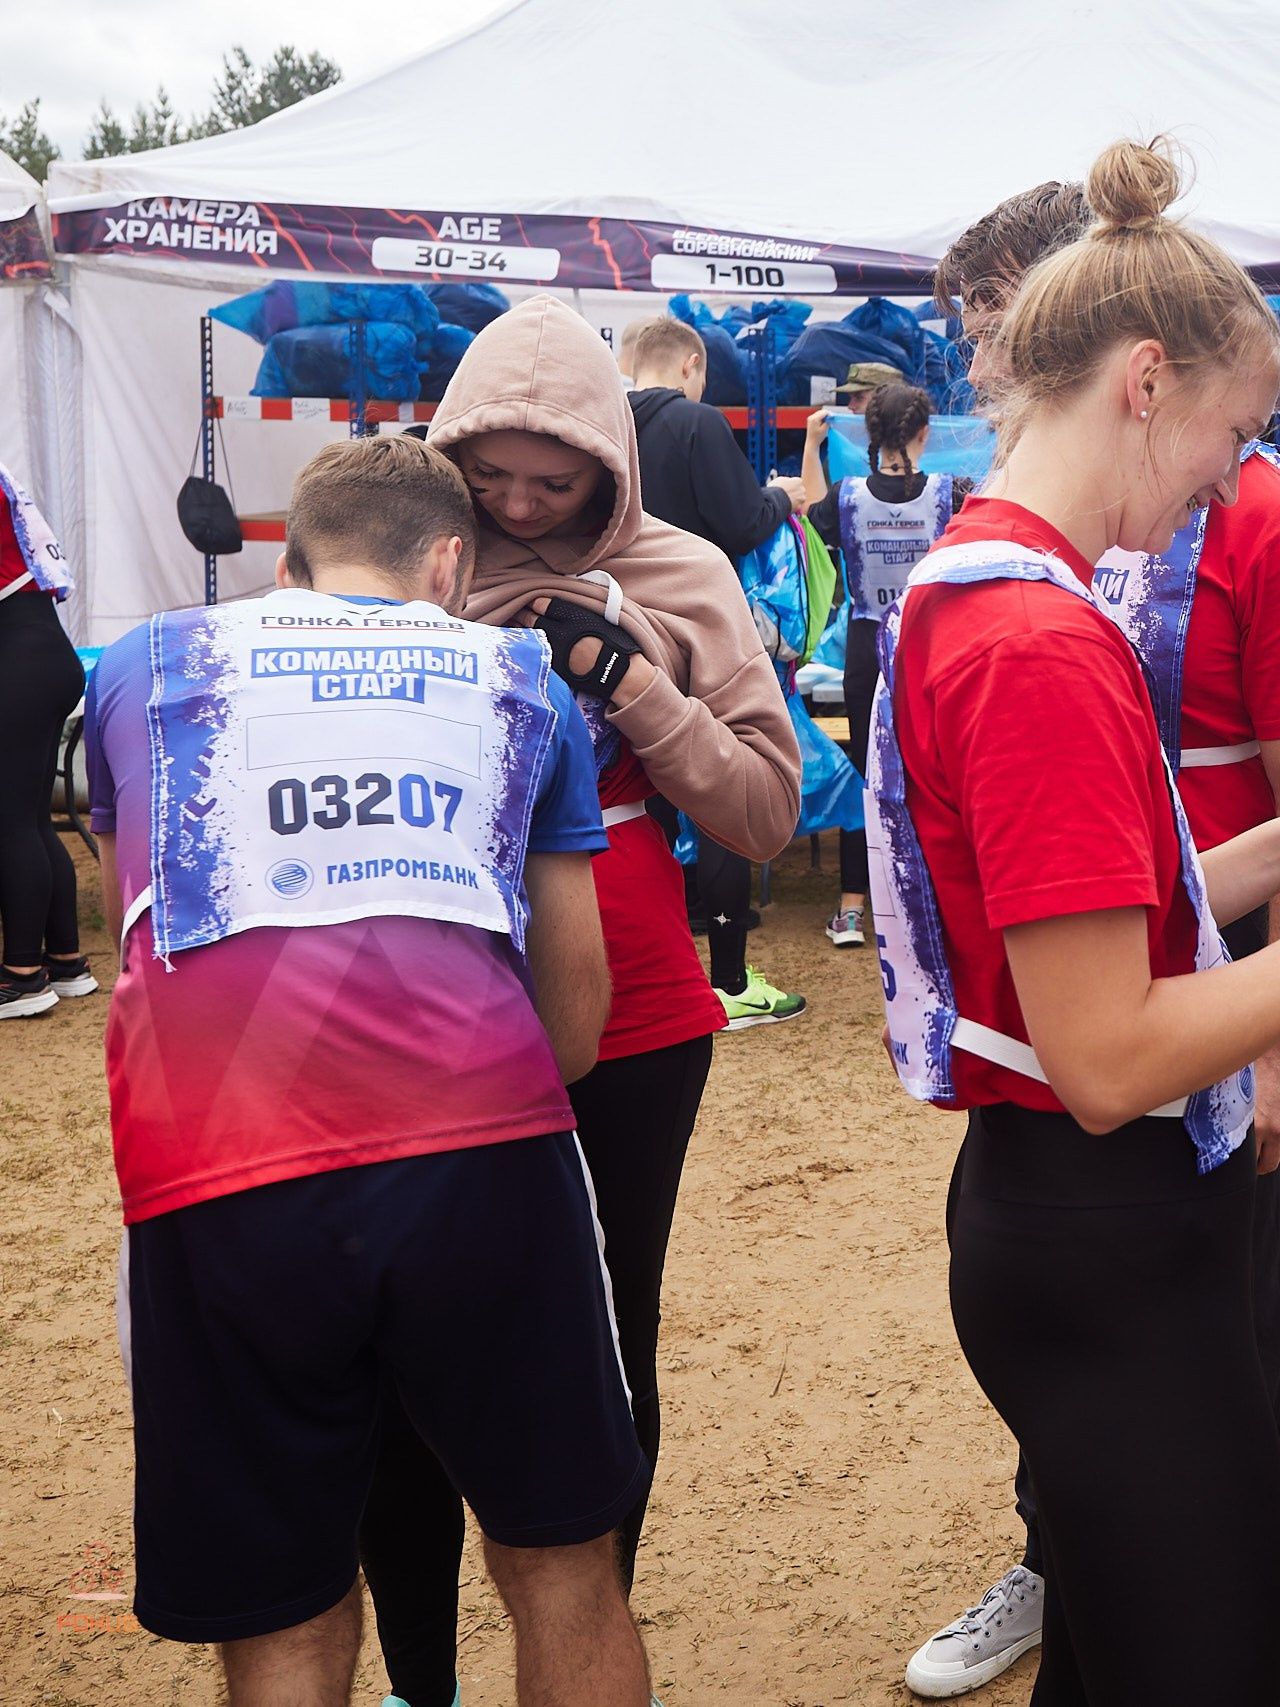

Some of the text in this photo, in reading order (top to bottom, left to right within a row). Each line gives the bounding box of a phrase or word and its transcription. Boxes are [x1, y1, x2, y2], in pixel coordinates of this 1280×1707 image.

[127, 197, 262, 227] КАМЕРА
[103, 217, 279, 256] ХРАНЕНИЯ
[437, 215, 502, 242] AGE
[415, 245, 508, 272] 30-34
[706, 263, 785, 288] 1-100
[885, 552, 913, 563] СТАРТ
[261, 616, 465, 630] ГОНКА ГЕРОЕВ
[254, 648, 475, 680] КОМАНДНЫЙ
[318, 672, 419, 699] СТАРТ
[268, 772, 463, 836] 03207
[326, 858, 479, 890] ГАЗПРОМБАНК
